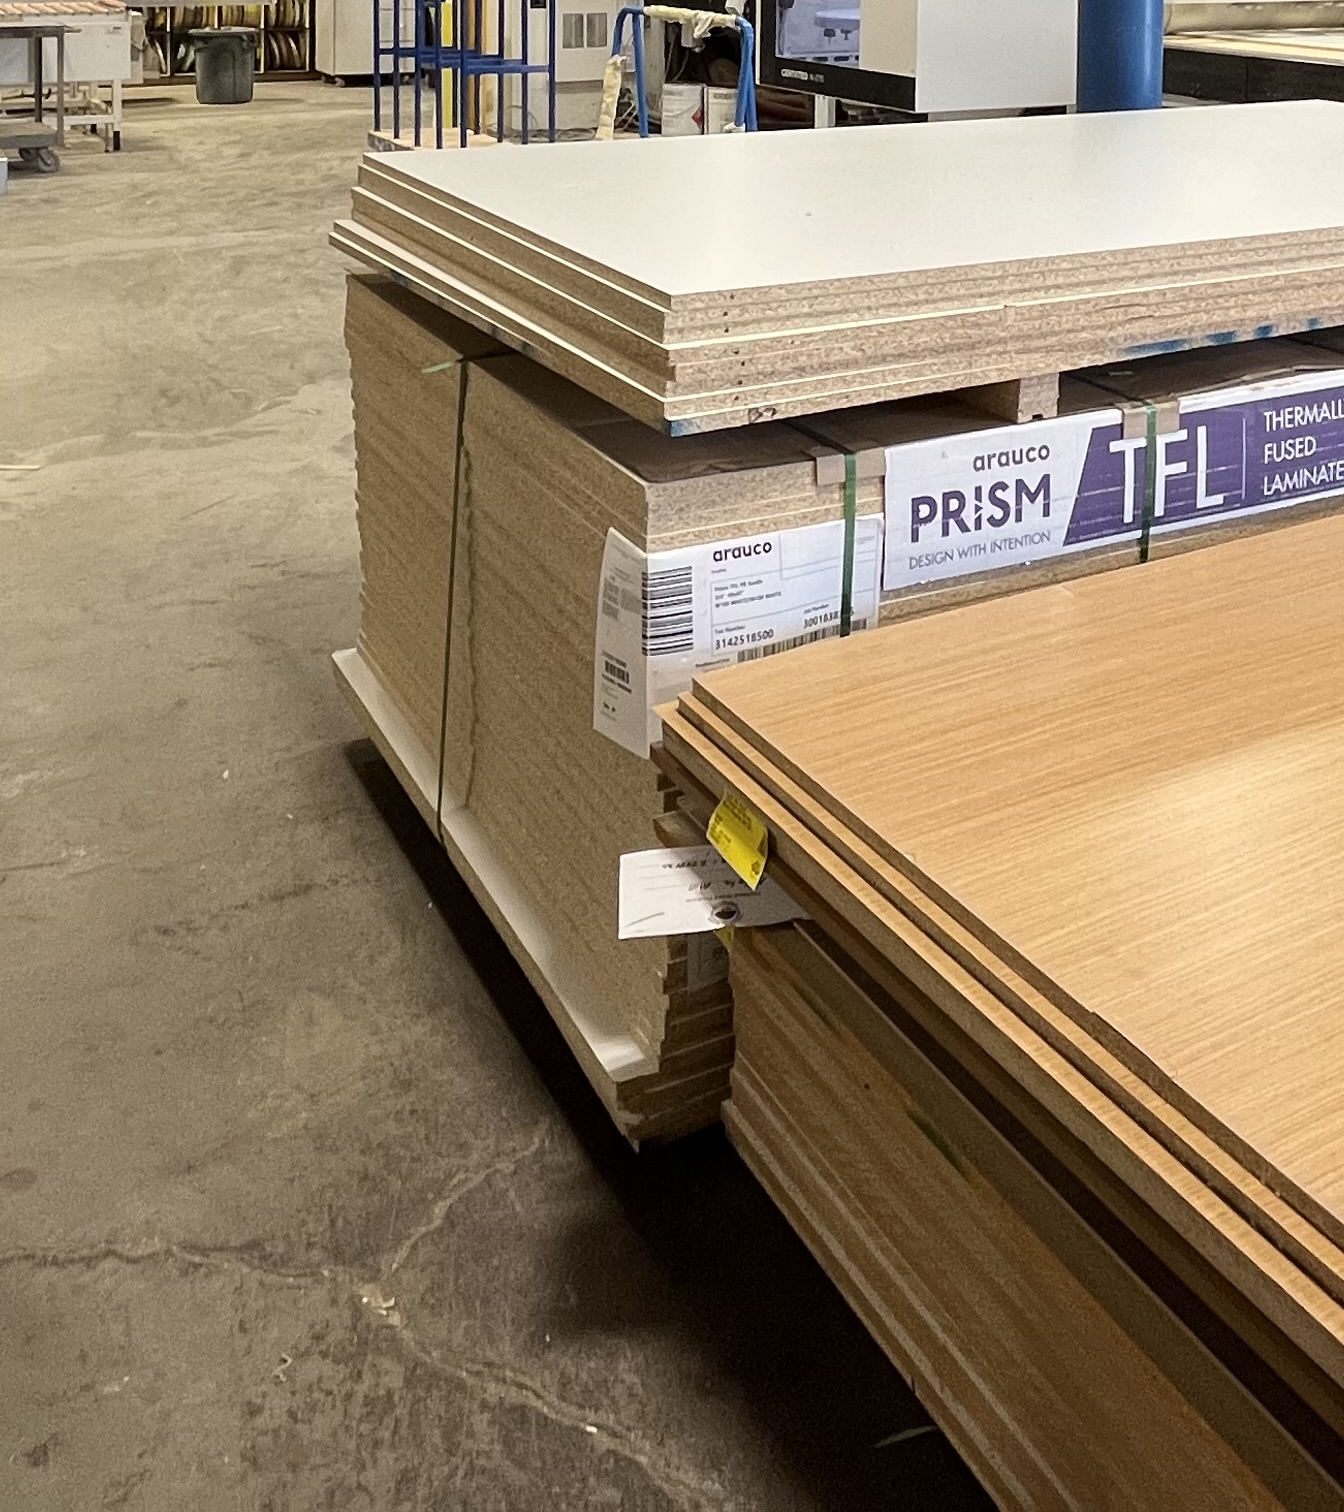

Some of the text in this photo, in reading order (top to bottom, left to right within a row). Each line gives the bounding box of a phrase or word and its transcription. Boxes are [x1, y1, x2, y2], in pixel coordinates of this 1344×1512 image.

[972, 444, 1051, 473] arauco
[1263, 436, 1318, 465] FUSED
[1108, 424, 1225, 525] TFL
[910, 473, 1052, 544] PRISM
[712, 540, 773, 563] arauco
[909, 530, 1052, 570] DESIGN WITH INTENTION
[715, 628, 774, 650] 3142518500
